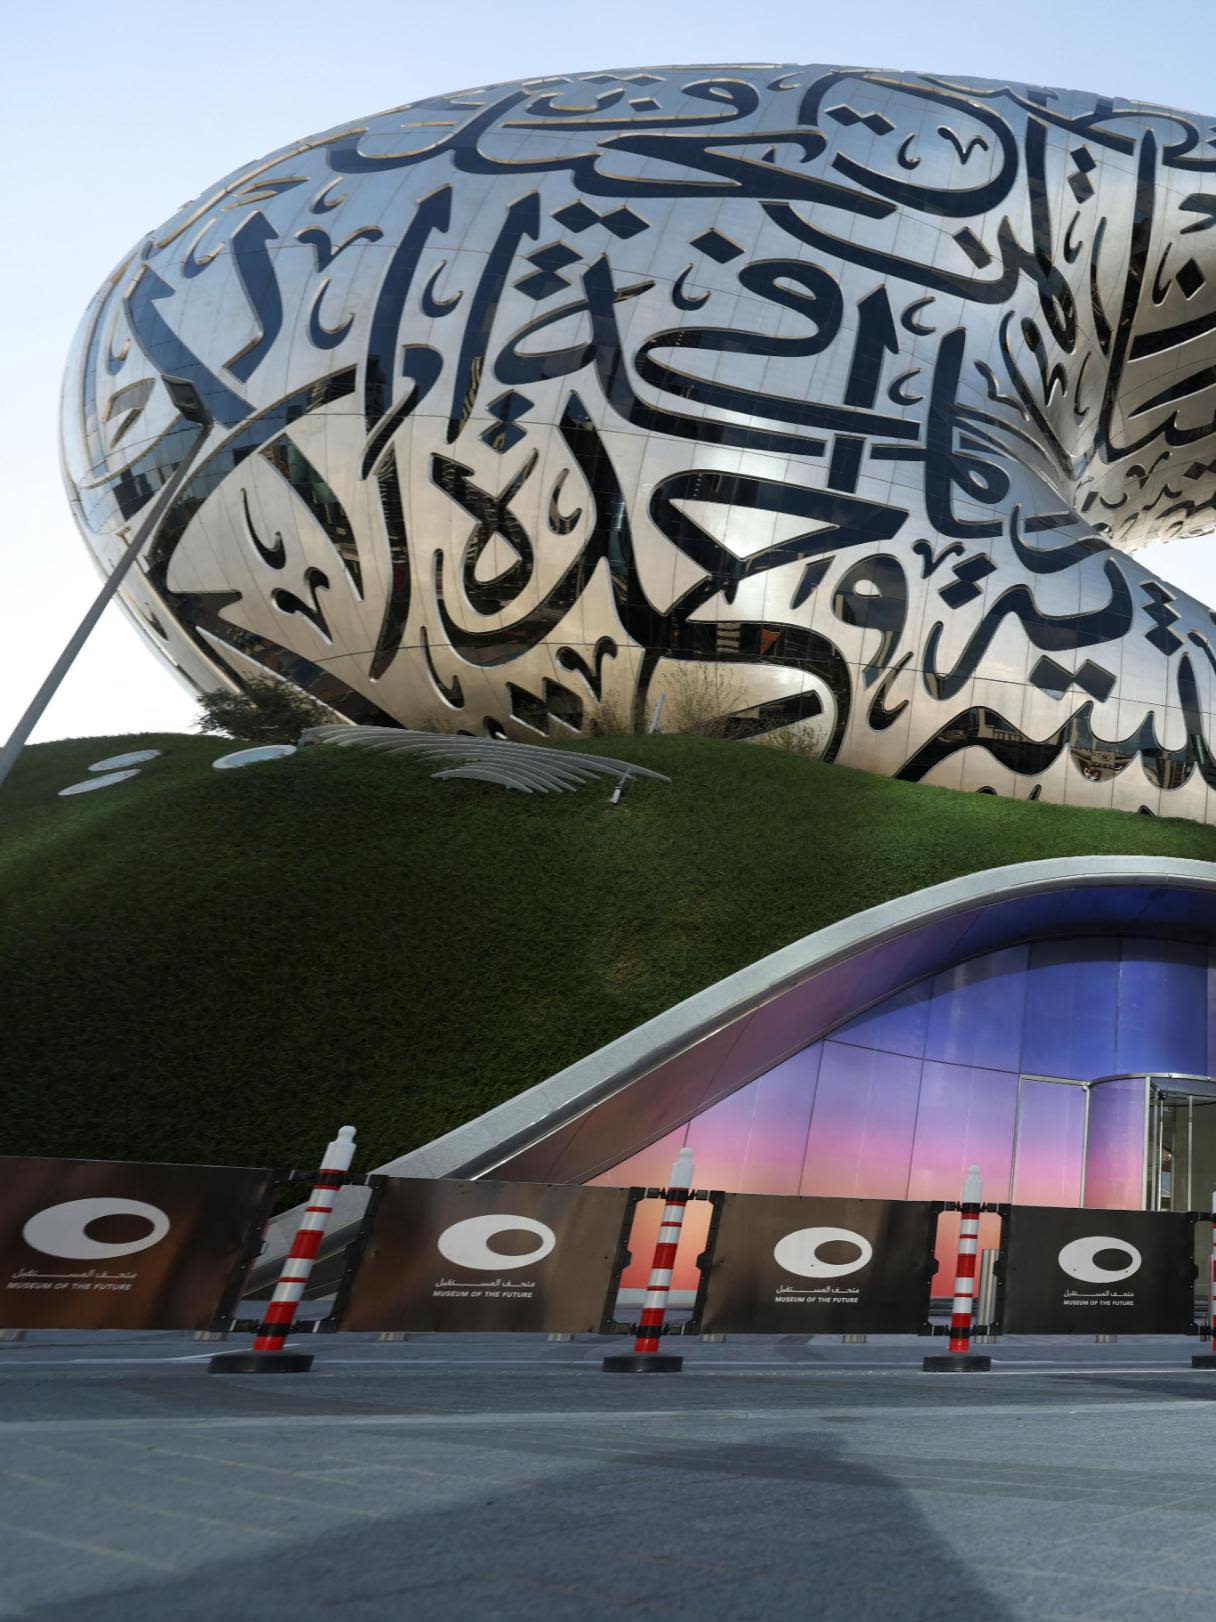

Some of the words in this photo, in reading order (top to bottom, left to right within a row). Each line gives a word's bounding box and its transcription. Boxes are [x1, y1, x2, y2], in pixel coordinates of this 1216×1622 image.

[7, 1282, 53, 1290] MUSEUM
[54, 1282, 70, 1290] OF
[71, 1283, 93, 1291] THE
[93, 1283, 133, 1291] FUTURE
[470, 1290, 482, 1298] OF
